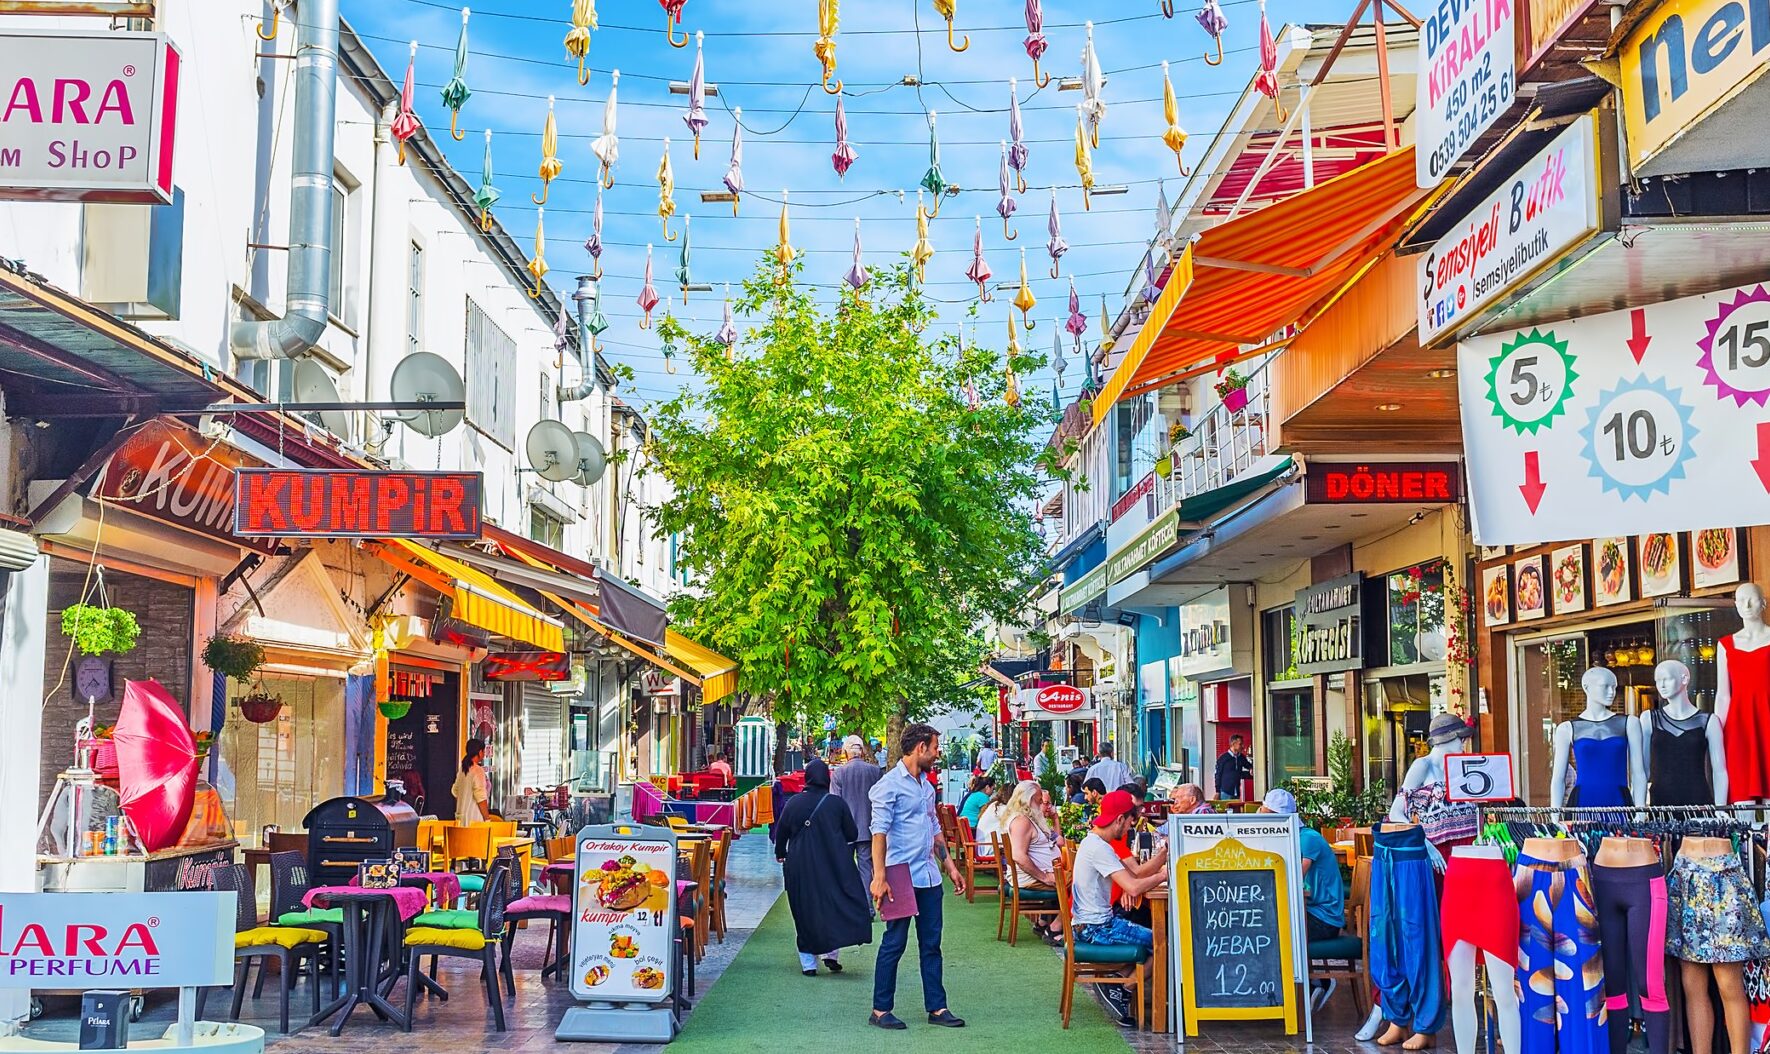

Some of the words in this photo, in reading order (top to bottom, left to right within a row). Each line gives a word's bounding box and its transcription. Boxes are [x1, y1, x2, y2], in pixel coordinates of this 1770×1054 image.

[1446, 80, 1467, 122] 450
[1471, 51, 1491, 95] m2
[0, 77, 135, 125] ARA
[1429, 130, 1455, 178] 0539
[1458, 103, 1477, 148] 504
[1480, 83, 1497, 124] 25
[1500, 64, 1514, 103] 61
[1509, 148, 1566, 236] Butik
[1719, 320, 1770, 371] 15
[1326, 466, 1449, 499] DÖNER
[646, 673, 674, 687] WC
[1460, 756, 1494, 797] 5
[1184, 825, 1224, 835] RANA
[1237, 827, 1289, 835] RESTORAN
[630, 843, 669, 853] Kumpir
[1215, 847, 1246, 858] RANA
[1196, 858, 1261, 869] RESTORAN
[1203, 881, 1265, 906] DÖNER
[637, 911, 648, 921] 12
[1206, 907, 1264, 930] KÖFTE
[1206, 935, 1271, 957] KEBAP
[10, 958, 160, 976] PERFUME
